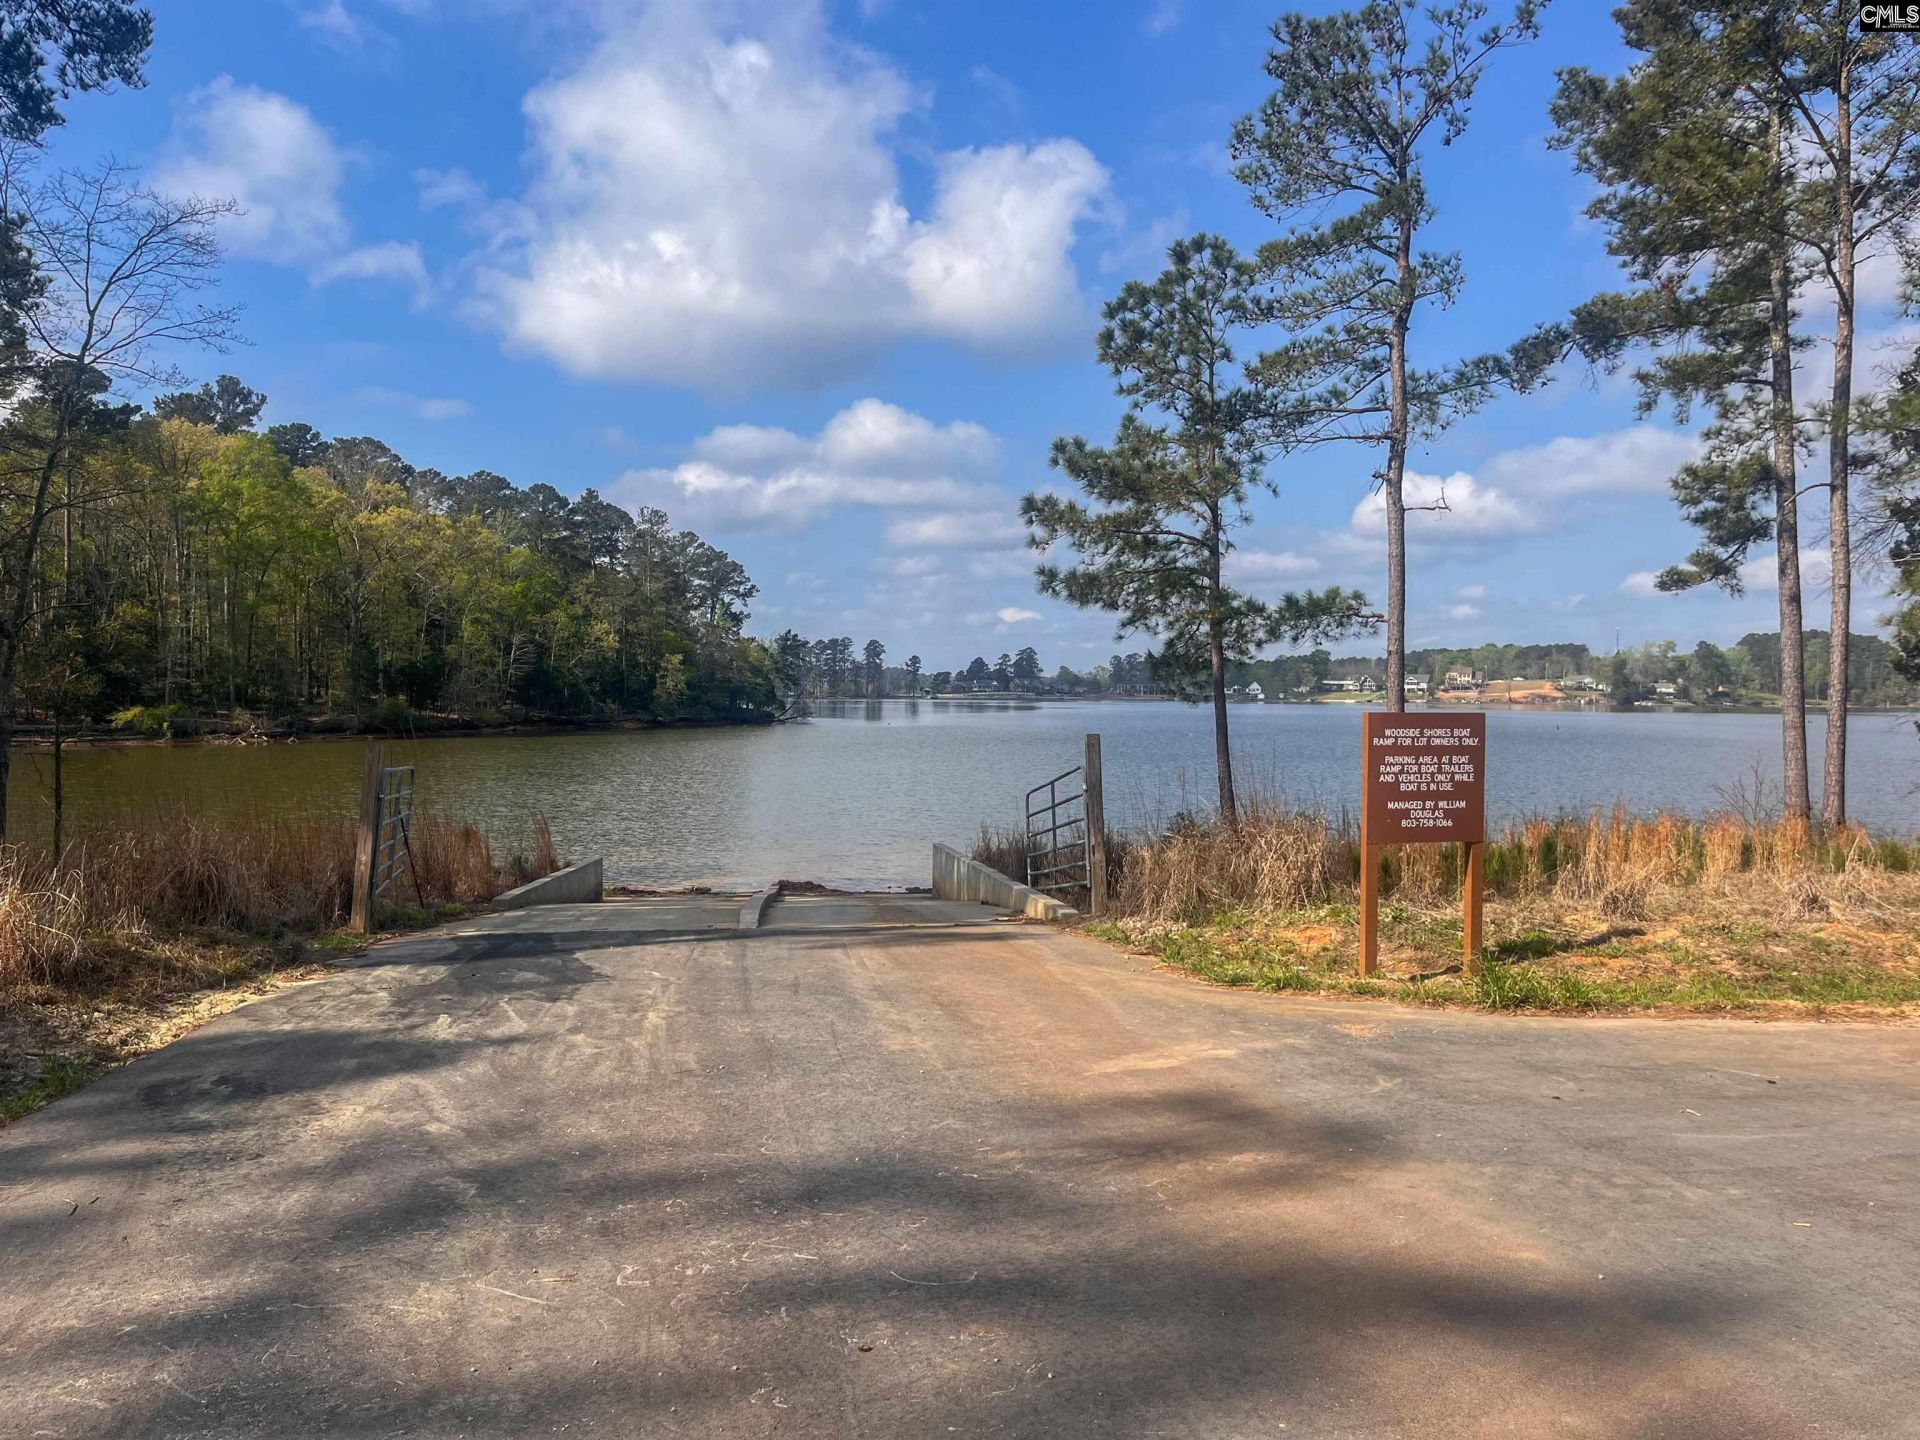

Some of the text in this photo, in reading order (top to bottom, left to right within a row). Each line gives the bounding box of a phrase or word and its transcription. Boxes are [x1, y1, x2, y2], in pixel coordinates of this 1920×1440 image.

[1384, 728, 1471, 737] WOODSIDE SHORES BOAT
[1373, 738, 1481, 746] RAMP FOR LOT OWNERS ONLY.
[1385, 756, 1470, 764] PARKING AREA AT BOAT
[1380, 765, 1474, 773] RAMP FOR BOAT TRAILERS
[1379, 774, 1474, 782] AND VEHICLES ONLY WHILE
[1400, 783, 1454, 791] BOAT IS IN USE.
[1388, 801, 1466, 809] MANAGED BY WILLIAM
[1410, 810, 1444, 818] DOUGLAS
[1401, 819, 1453, 827] 803-758-1066
